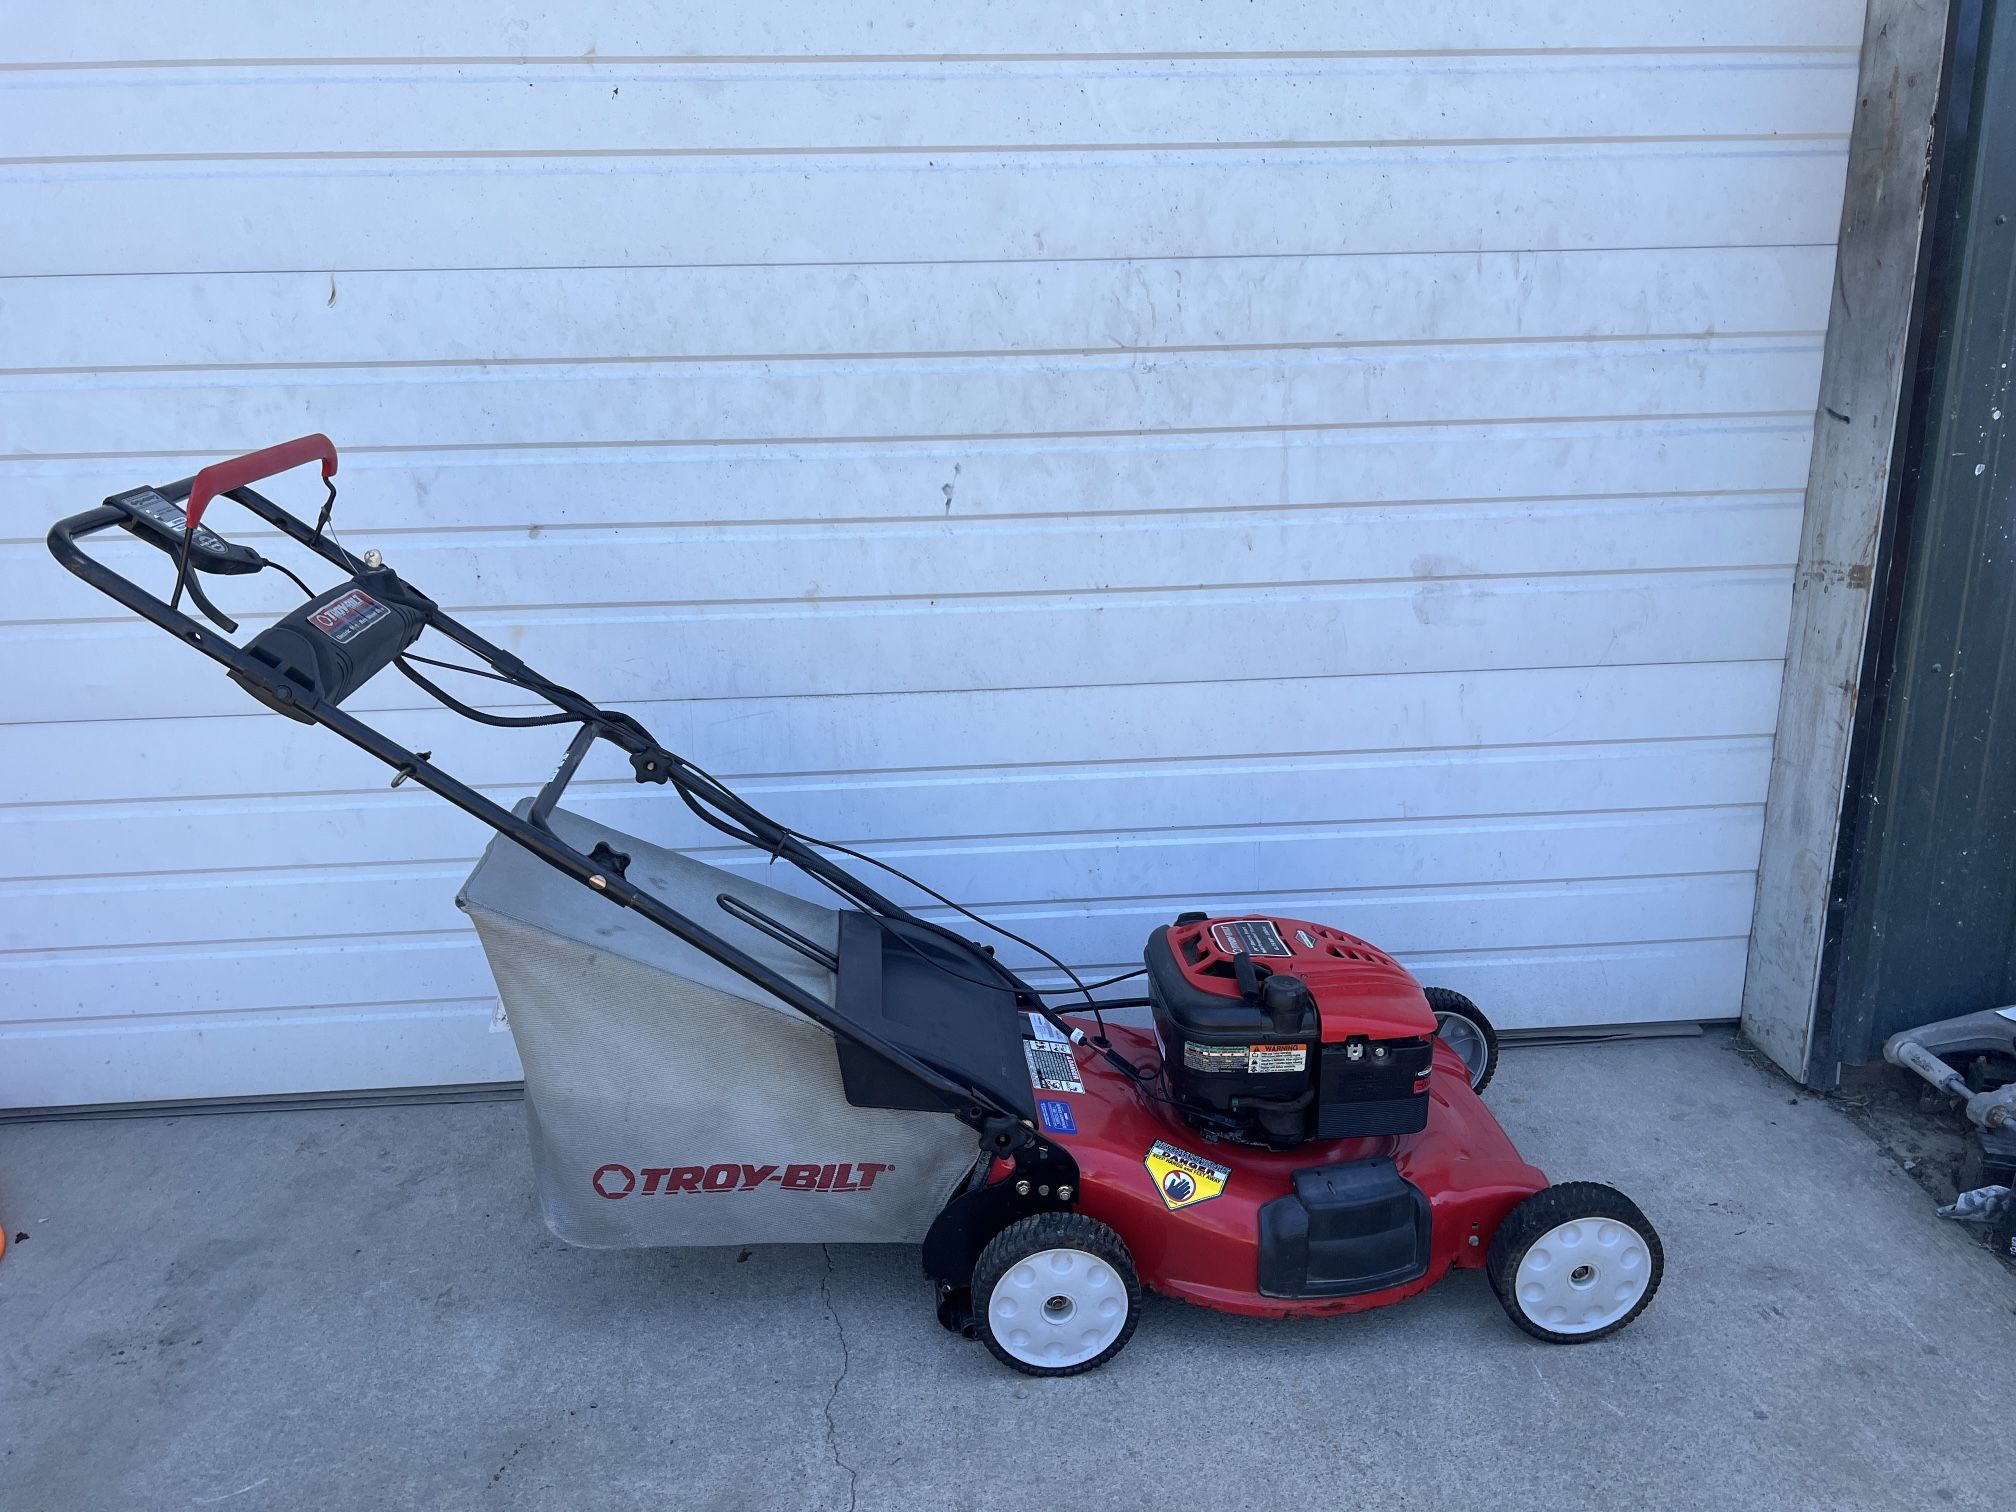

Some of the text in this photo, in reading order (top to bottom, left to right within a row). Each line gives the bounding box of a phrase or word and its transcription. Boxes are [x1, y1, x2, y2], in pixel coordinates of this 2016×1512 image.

[1265, 1044, 1298, 1052] WARNING
[1152, 1153, 1166, 1162] KEEP
[1166, 1158, 1183, 1169] HANDS
[1193, 1169, 1205, 1178] FEET
[1206, 1174, 1221, 1184] AWAY
[1162, 1151, 1216, 1176] DANGER
[640, 1163, 888, 1195] TROY-BILT
